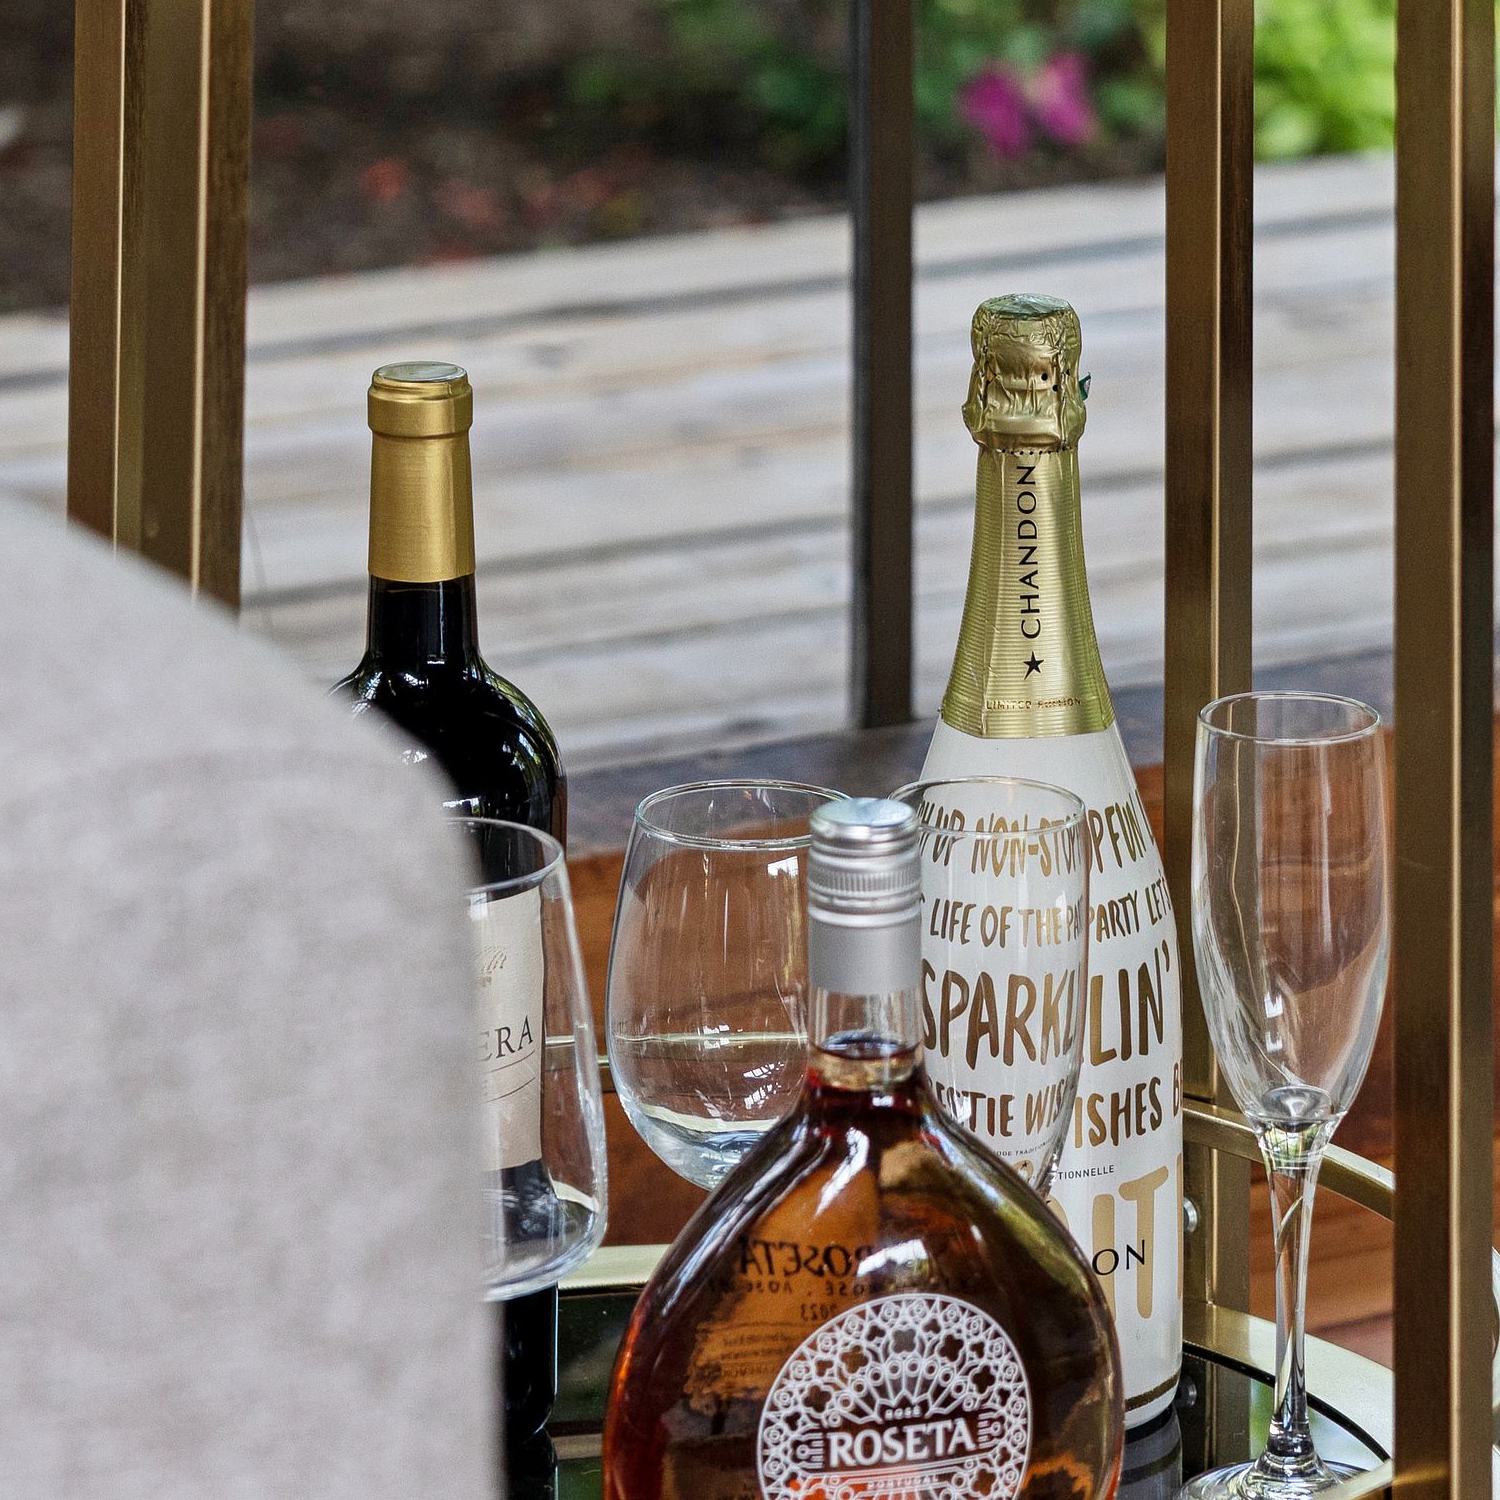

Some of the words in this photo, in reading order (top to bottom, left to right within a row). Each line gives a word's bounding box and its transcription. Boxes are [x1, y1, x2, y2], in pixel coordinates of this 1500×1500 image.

[1016, 465, 1042, 640] CHANDON
[986, 700, 1032, 711] LIMITED
[932, 805, 966, 866] UP
[1105, 792, 1147, 868] FUN
[930, 898, 977, 946] LIFE
[980, 904, 1013, 949] OF
[1018, 906, 1062, 948] THE
[1086, 889, 1140, 943] PARTY
[479, 1014, 534, 1062] ERA
[1058, 1164, 1115, 1180] TIONNELLE
[1091, 1239, 1145, 1276] ON
[826, 1417, 977, 1469] ROSETA
